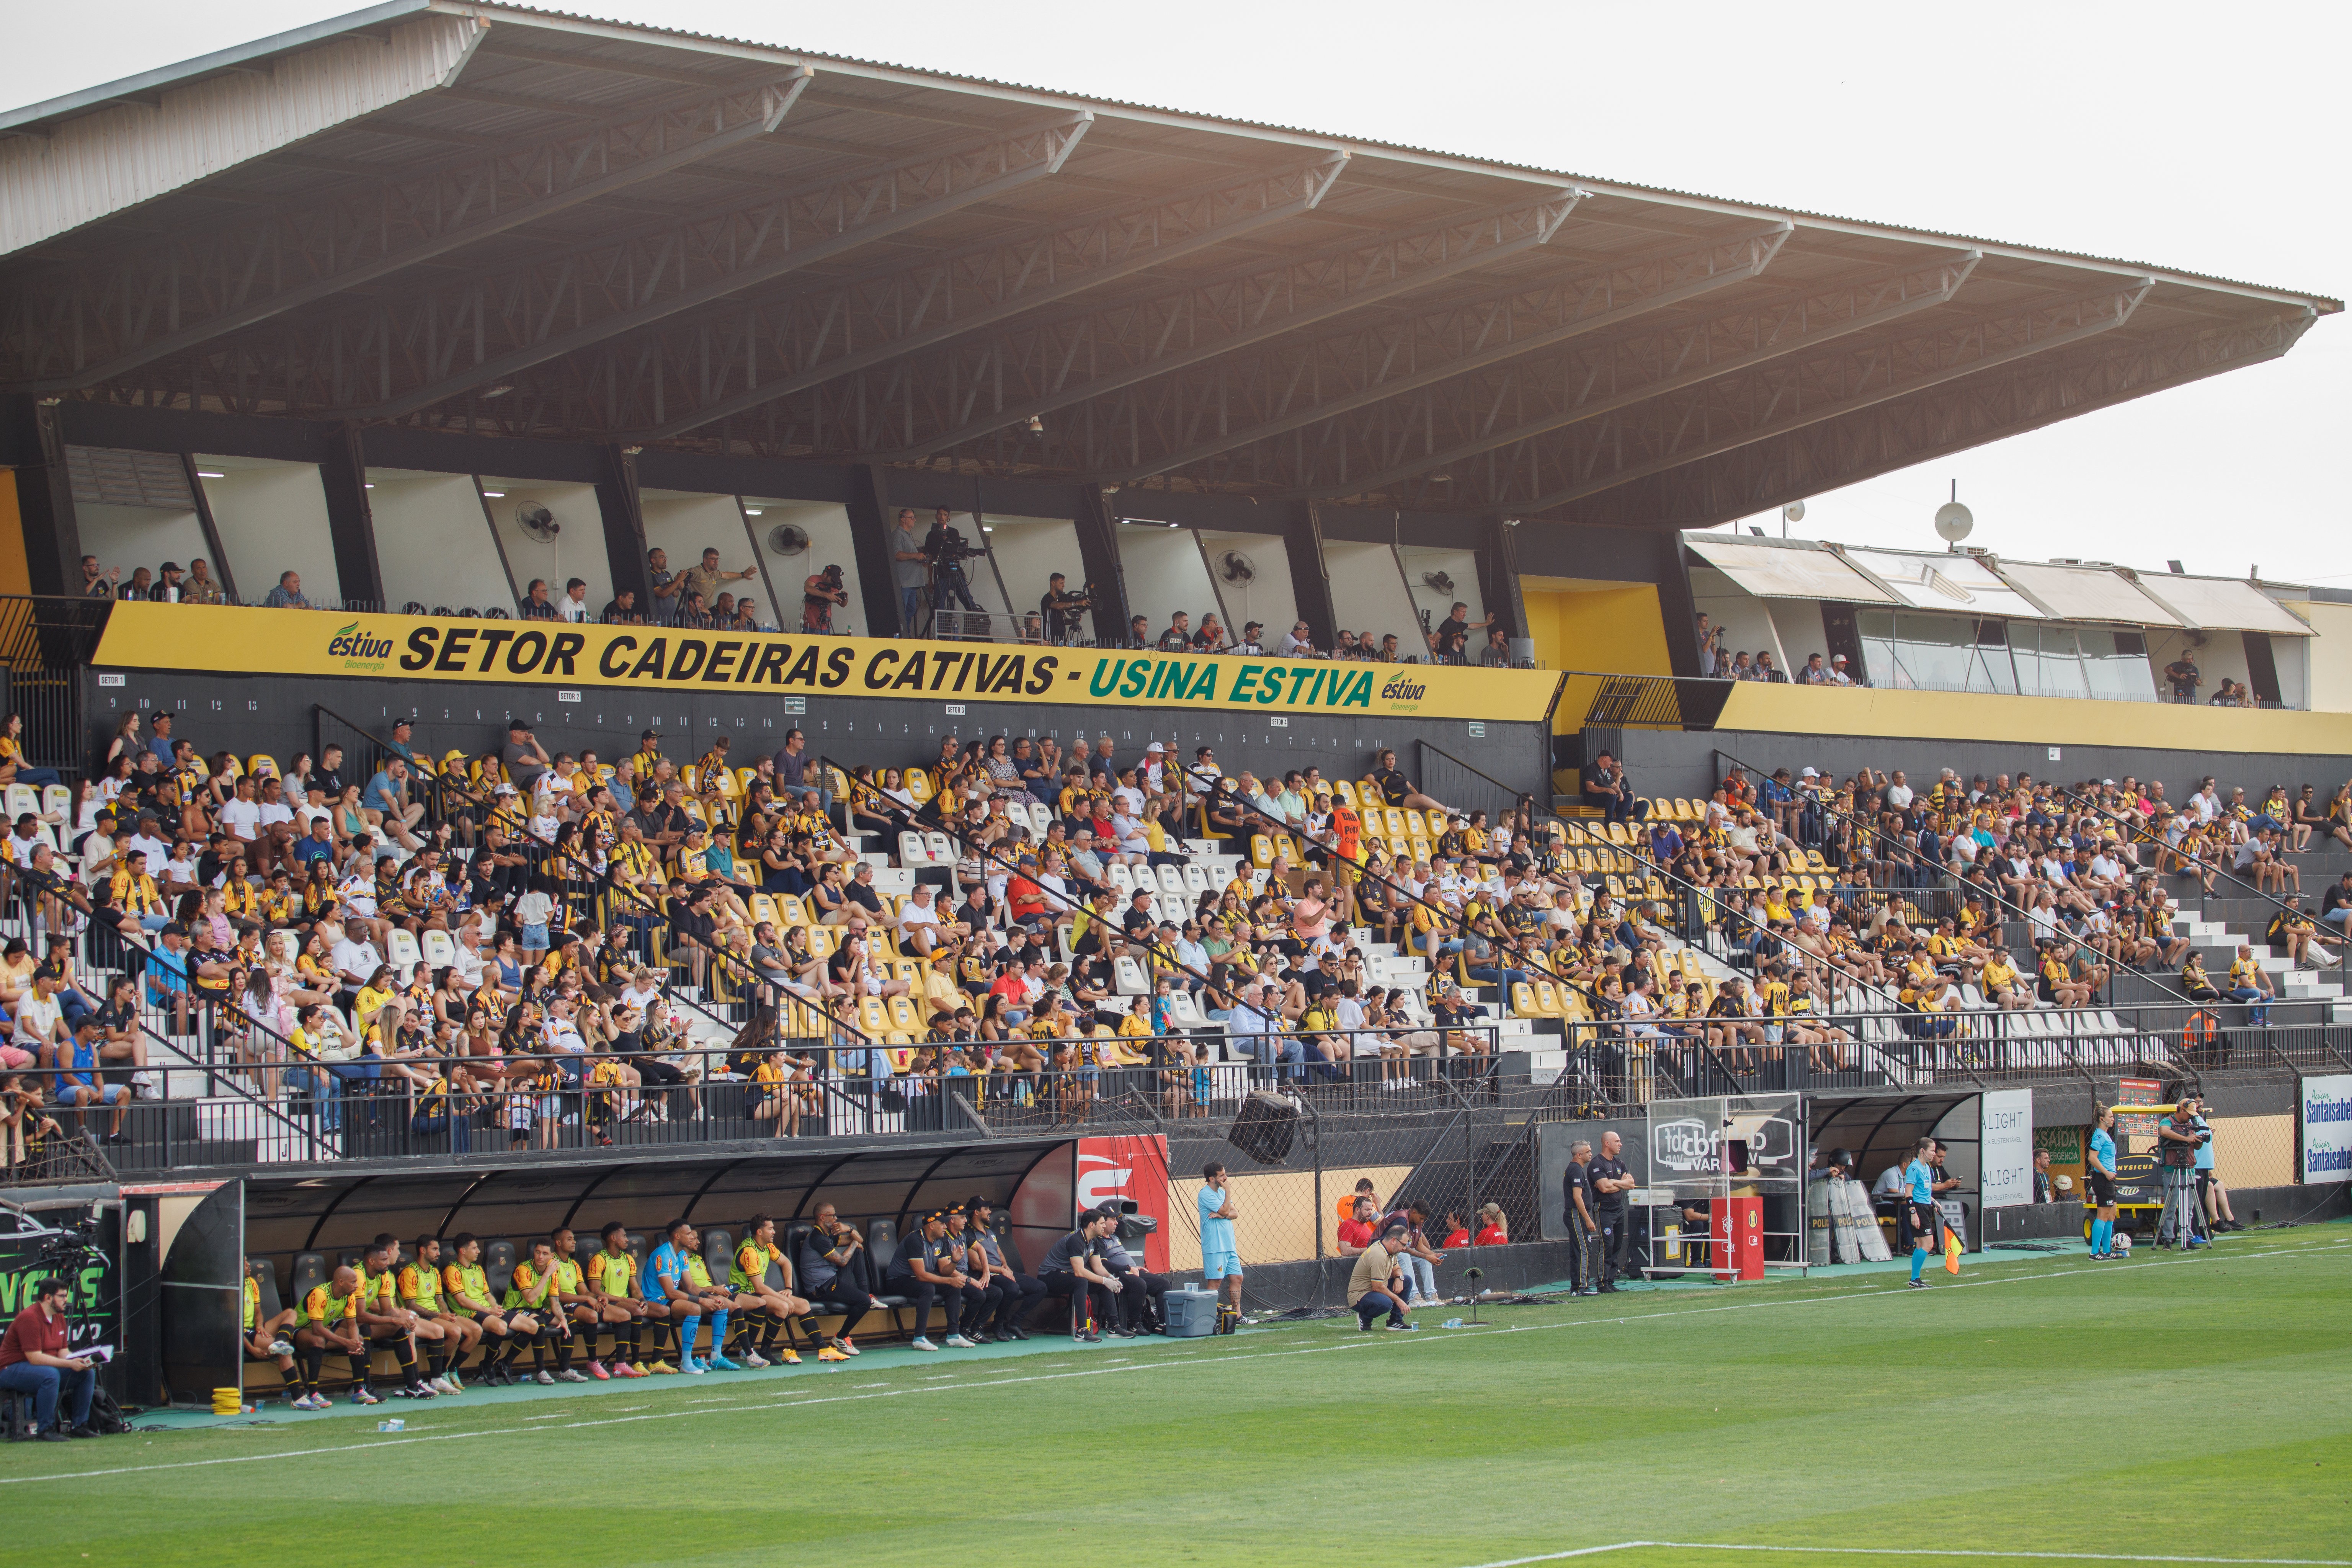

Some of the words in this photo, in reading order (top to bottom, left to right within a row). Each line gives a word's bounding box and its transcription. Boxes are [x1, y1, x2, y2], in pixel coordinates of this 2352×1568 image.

[328, 631, 394, 658] estiva
[344, 660, 385, 672] Bioenergia
[400, 627, 585, 675] SETOR
[599, 635, 855, 688] CADEIRAS
[864, 649, 1058, 695] CATIVAS
[1067, 671, 1081, 680] -
[1089, 658, 1218, 700] USINA
[1228, 665, 1374, 707] ESTIVA
[1381, 678, 1426, 700] estiva
[110, 698, 116, 708] 9
[139, 699, 150, 709] 10
[178, 699, 186, 709] 11
[212, 700, 221, 710] 12
[248, 701, 257, 710] 13
[1390, 703, 1418, 712] Bioenergia
[413, 707, 417, 717] 2
[444, 709, 449, 719] 3
[476, 710, 480, 720] 4
[505, 711, 510, 720] 5
[537, 712, 541, 722] 6
[565, 713, 570, 722] 7
[598, 714, 602, 724] 8
[627, 715, 632, 724] 9
[652, 716, 661, 725] 10
[680, 717, 687, 726] 11
[709, 717, 717, 727] 12
[736, 718, 744, 727] 13
[764, 718, 771, 727] 14
[823, 721, 827, 730] 2
[849, 722, 853, 731] 3
[878, 723, 881, 732] 4
[904, 724, 908, 733] 5
[929, 725, 933, 734] 6
[954, 726, 957, 735] 7
[979, 727, 982, 735] 8
[1004, 728, 1008, 736] 9
[1028, 728, 1036, 737] 10
[1051, 729, 1057, 738] 11
[1076, 730, 1083, 738] 12
[1124, 731, 1130, 739] 14
[1173, 732, 1177, 740] 2
[1196, 732, 1199, 740] 3
[1219, 733, 1222, 742] 4
[1242, 735, 1246, 743] 5
[1265, 735, 1269, 744] 6
[1289, 737, 1292, 745] 7
[1312, 738, 1315, 746] 8
[1333, 738, 1336, 746] 9
[1355, 739, 1362, 747] 10
[1375, 740, 1381, 748] 11
[1341, 812, 1357, 822] BAR
[1207, 843, 1212, 853] B
[899, 872, 904, 882] C
[1257, 873, 1262, 882] C
[555, 905, 563, 921] 9
[953, 904, 957, 913] D
[1361, 932, 1365, 941] E
[967, 960, 972, 972] 7
[1413, 960, 1416, 970] F
[2297, 973, 2301, 983] G
[1467, 991, 1471, 1001] G
[1775, 991, 1782, 1005] 14
[1119, 1003, 1124, 1012] G
[1520, 1023, 1524, 1033] H
[1082, 1042, 1092, 1053] 30
[1991, 1136, 2022, 1145] SUSTENTÁVEL
[2041, 1127, 2078, 1147] SAÍDA
[1682, 1130, 1719, 1156] cbf
[1692, 1158, 1720, 1171] VAR
[1983, 1168, 2024, 1186] ALIGHT
[1994, 1192, 2024, 1201] SUSTENTÁVEL
